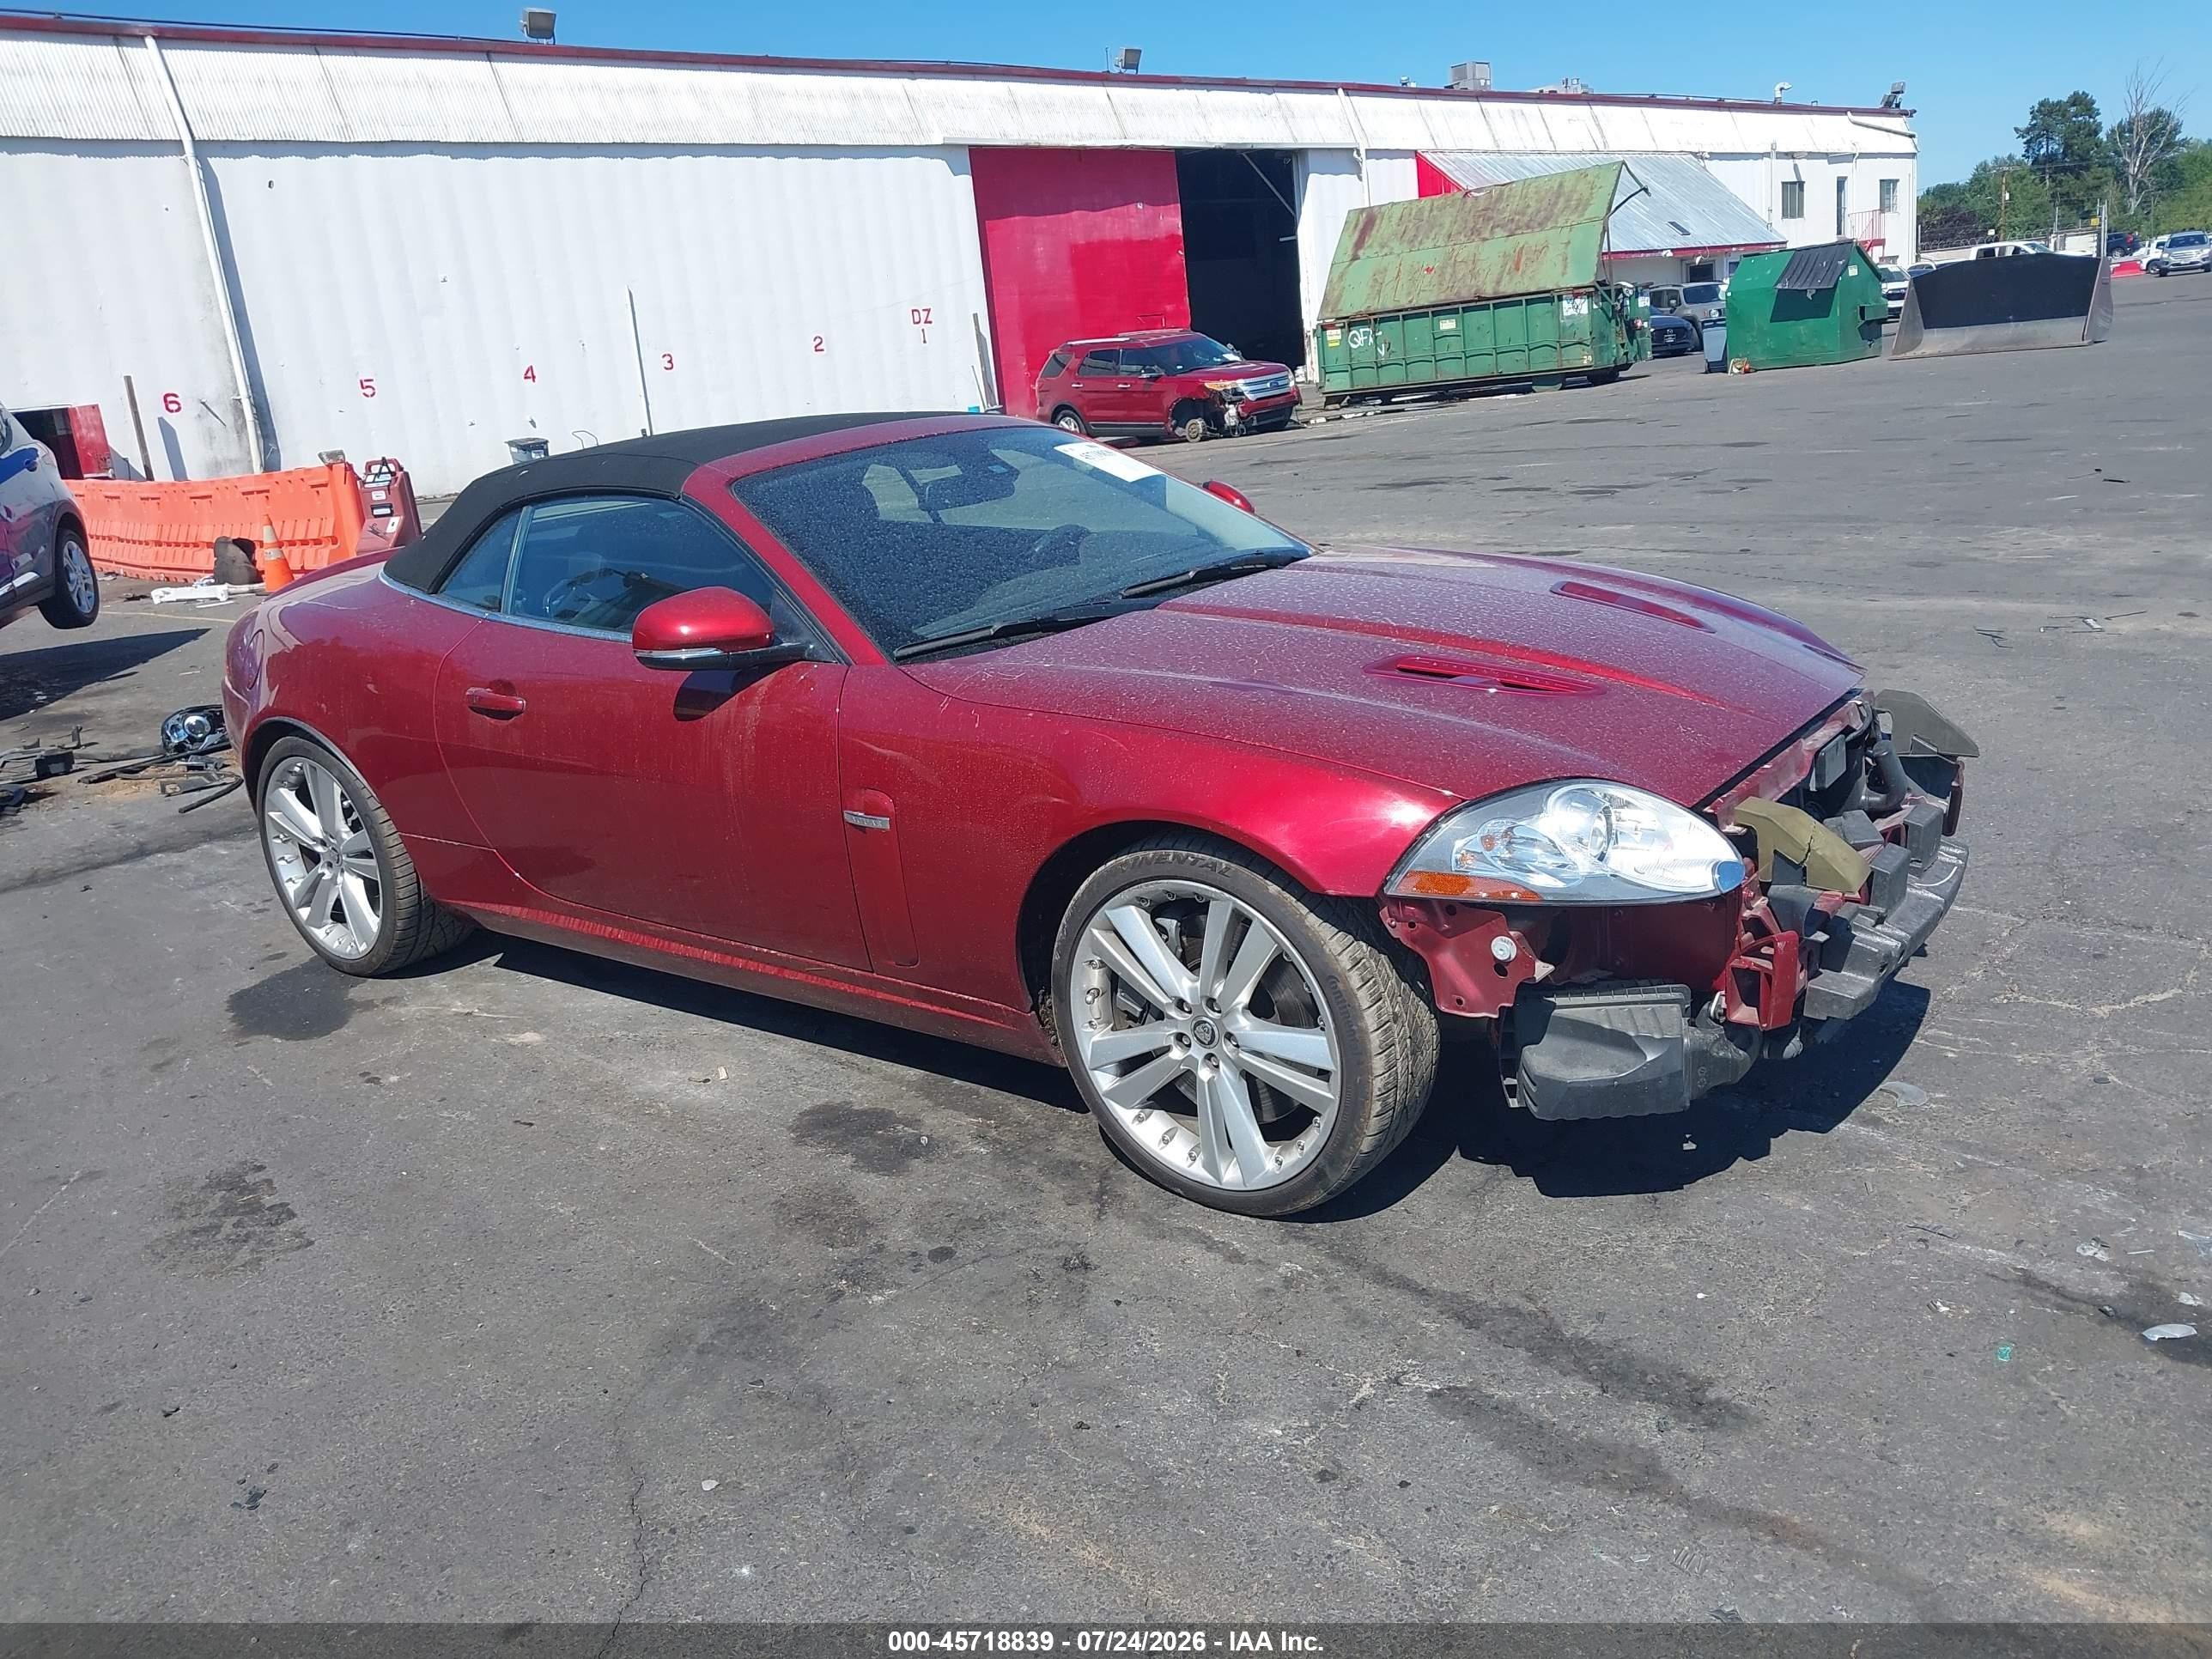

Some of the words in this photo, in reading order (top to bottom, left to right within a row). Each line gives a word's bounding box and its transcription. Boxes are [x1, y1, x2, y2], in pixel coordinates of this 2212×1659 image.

[911, 307, 933, 325] DZ
[813, 336, 824, 353] 2
[921, 328, 927, 343] 1
[662, 353, 674, 371] 3
[523, 365, 537, 383] 4
[359, 378, 377, 398] 5
[162, 392, 182, 413] 6
